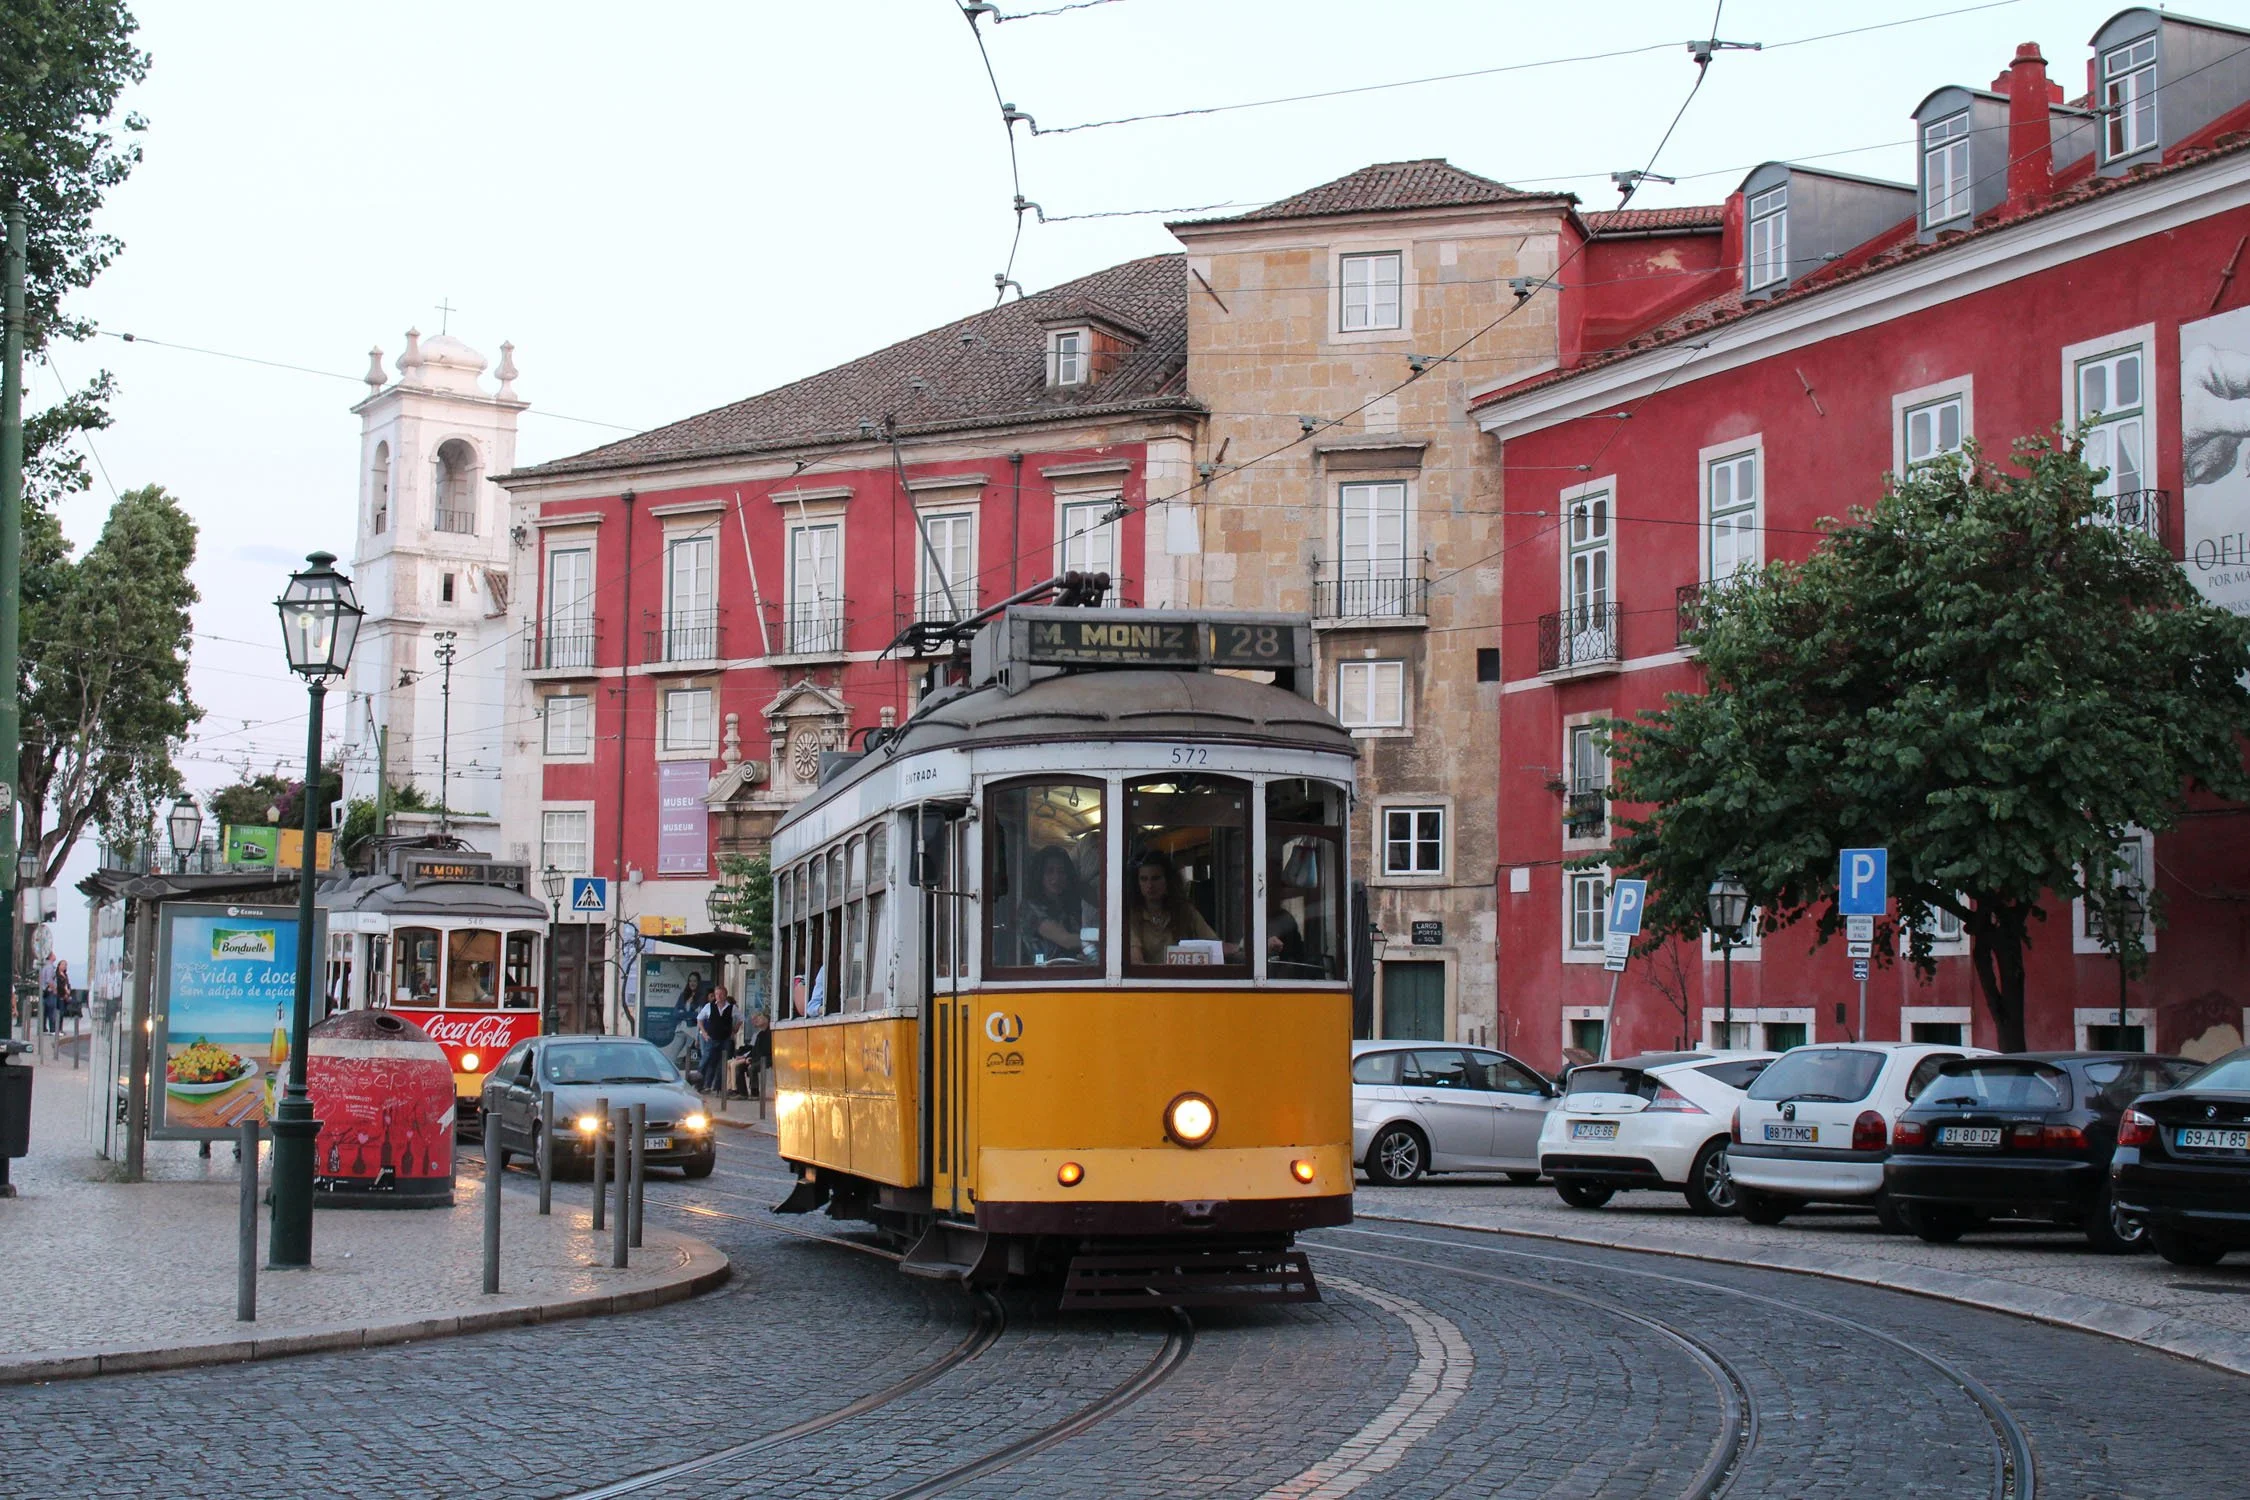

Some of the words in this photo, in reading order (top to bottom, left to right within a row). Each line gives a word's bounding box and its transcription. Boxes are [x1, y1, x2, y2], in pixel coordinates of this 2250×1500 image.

[2196, 533, 2250, 570] OFI
[2208, 574, 2232, 588] POR
[1034, 624, 1065, 645] M.
[1081, 625, 1183, 648] MONIZ
[1231, 627, 1279, 657] 28
[1172, 748, 1207, 765] 572
[905, 769, 938, 785] ENTRADA
[663, 797, 694, 807] MUSEU
[663, 823, 694, 832] MUSEUM
[495, 868, 517, 881] 28
[1852, 854, 1875, 899] P
[1616, 888, 1638, 925] P
[222, 942, 267, 955] Bonduelle
[180, 972, 193, 984] A
[202, 967, 236, 984] vida
[245, 967, 253, 984] é
[260, 967, 296, 984] doce
[180, 986, 203, 997] Sem
[208, 986, 244, 999] adição
[248, 986, 260, 996] de
[265, 985, 296, 999] açúca
